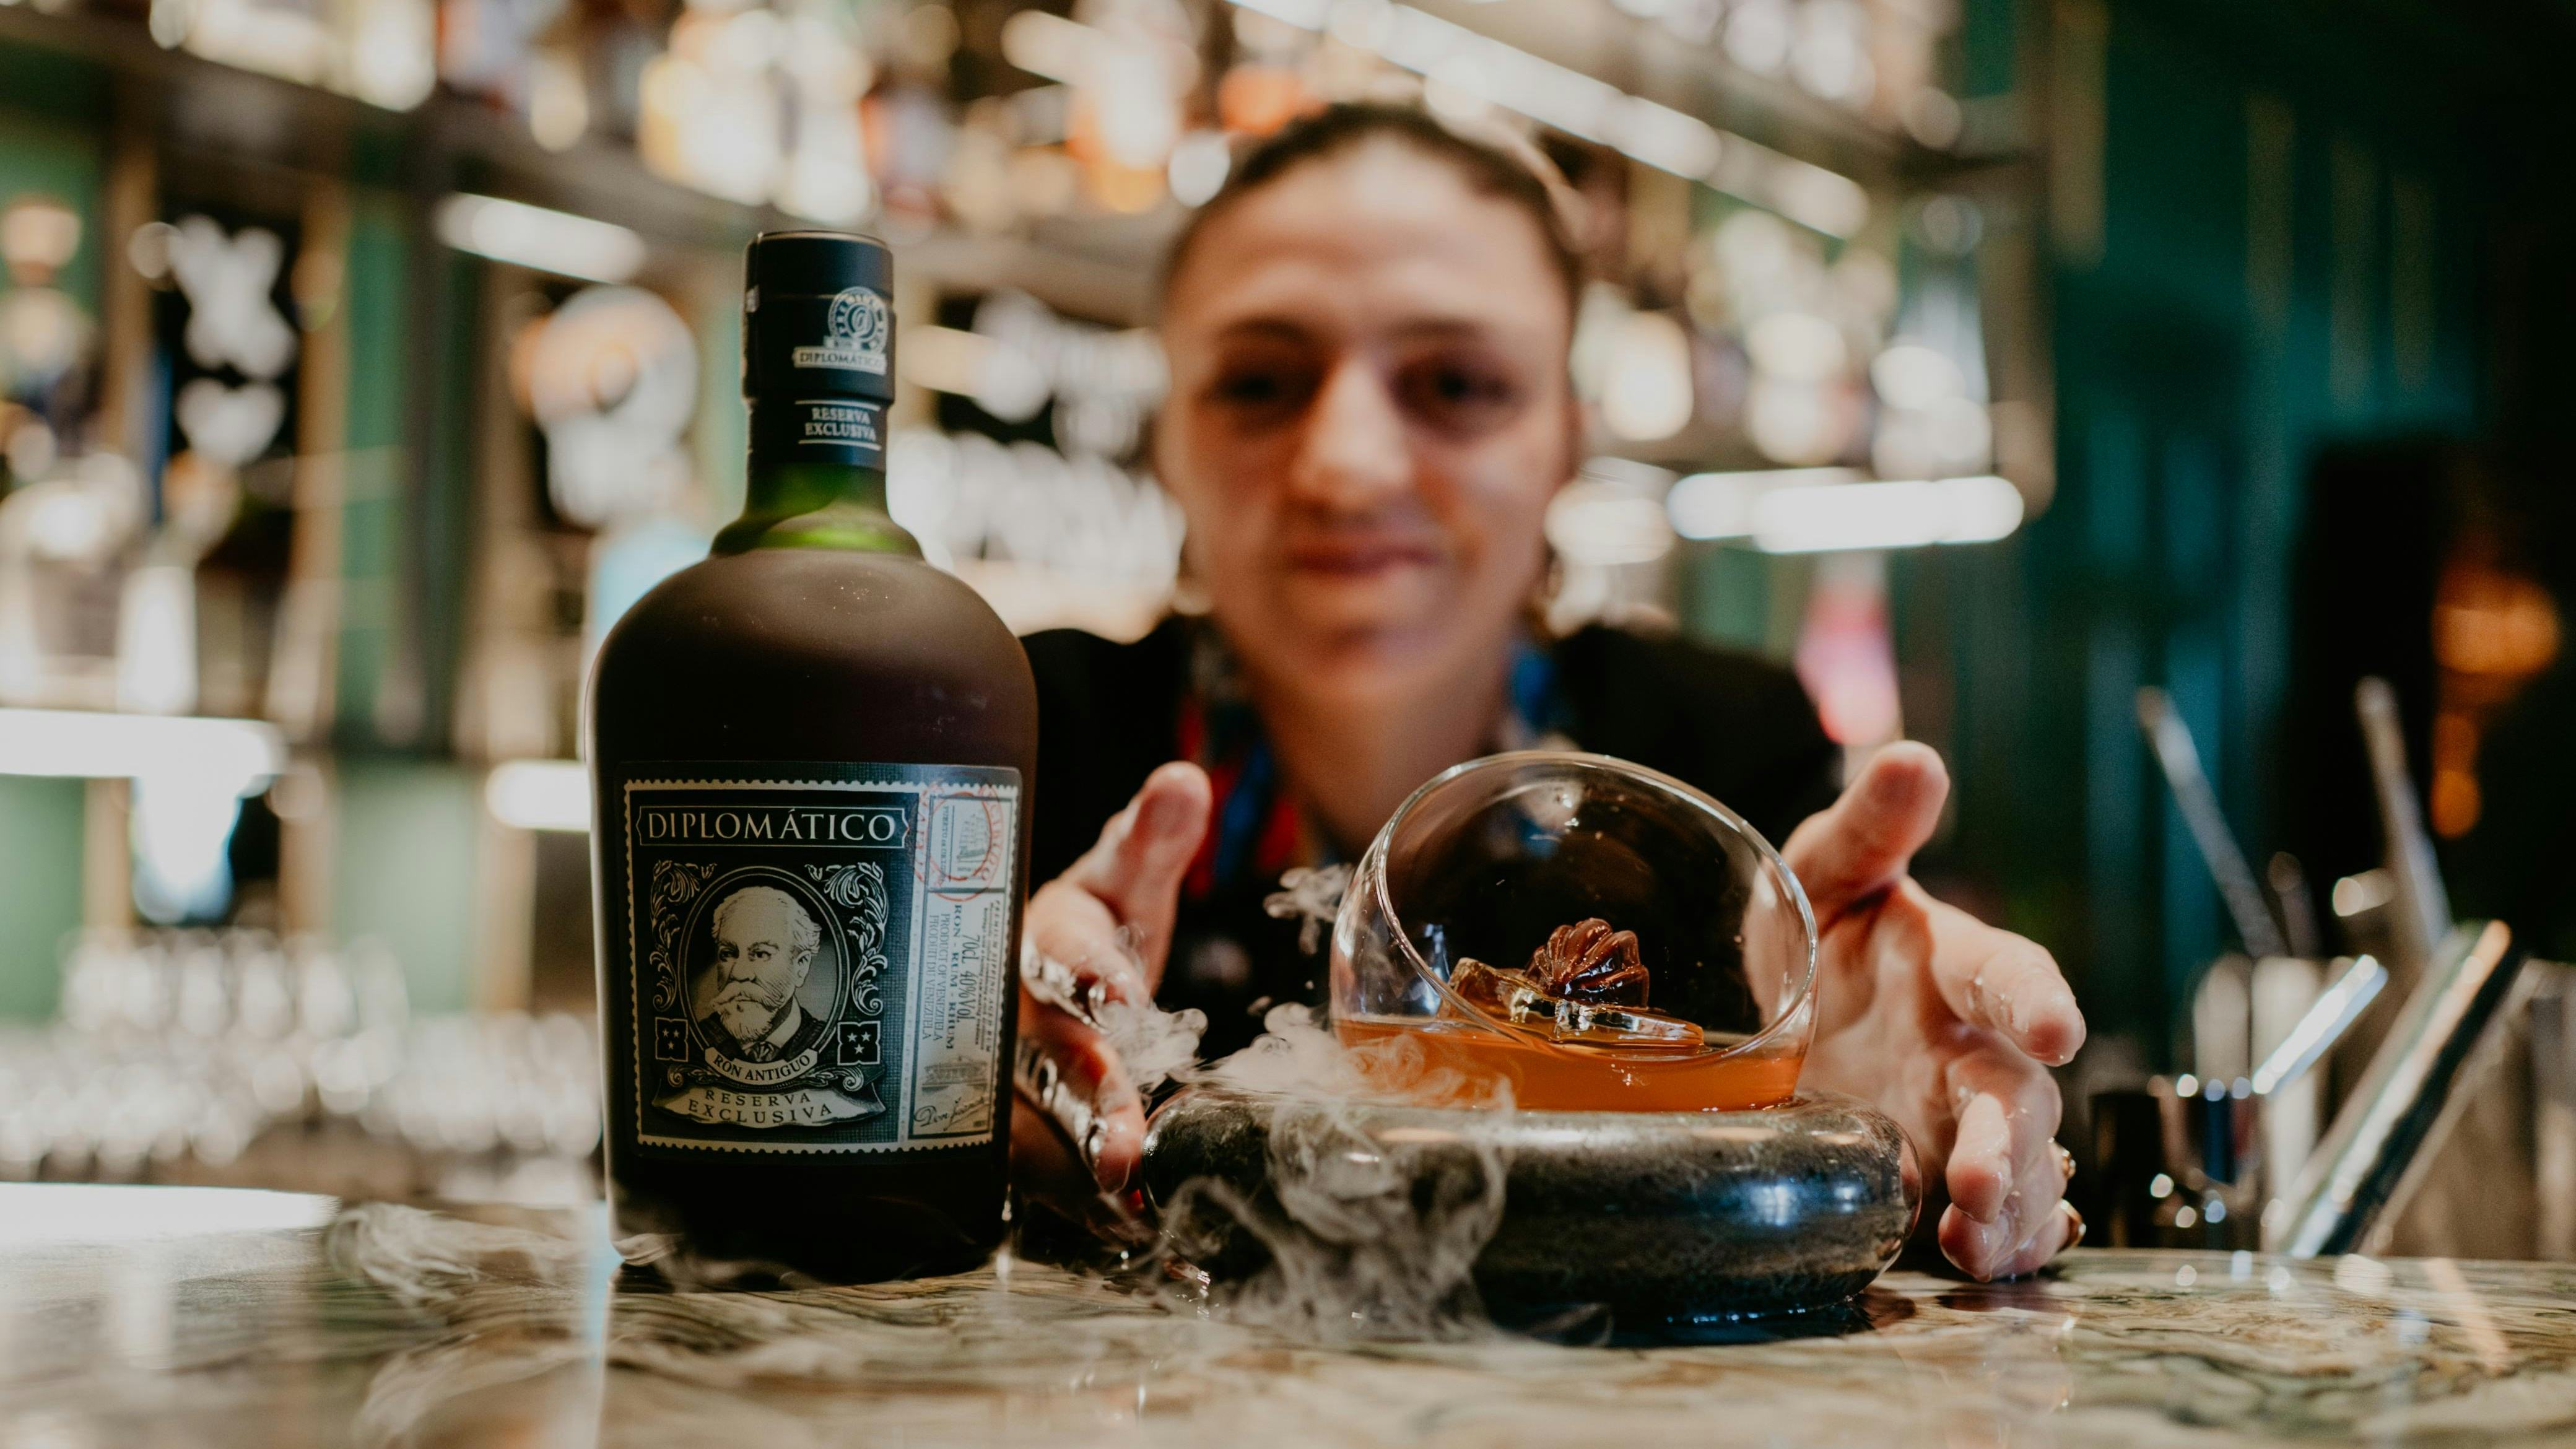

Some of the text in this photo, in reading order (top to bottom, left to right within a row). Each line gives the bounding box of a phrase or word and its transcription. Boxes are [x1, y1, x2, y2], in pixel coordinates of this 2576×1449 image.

[805, 422, 877, 442] EXCLUSIVA
[811, 407, 871, 424] RESERVA
[648, 809, 896, 842] DIPLOMÁTICO
[954, 905, 962, 938] RON
[922, 915, 939, 1040] PRODUIT DU VENEZUELA
[933, 913, 951, 1042] PRODUCT OF VENEZUELA
[949, 952, 959, 988] RUM
[946, 1001, 957, 1050] RHUM
[713, 1054, 811, 1081] RON ANTIGUO
[688, 1099, 833, 1124] EXCLUSIVA
[705, 1087, 811, 1107] RESERVA
